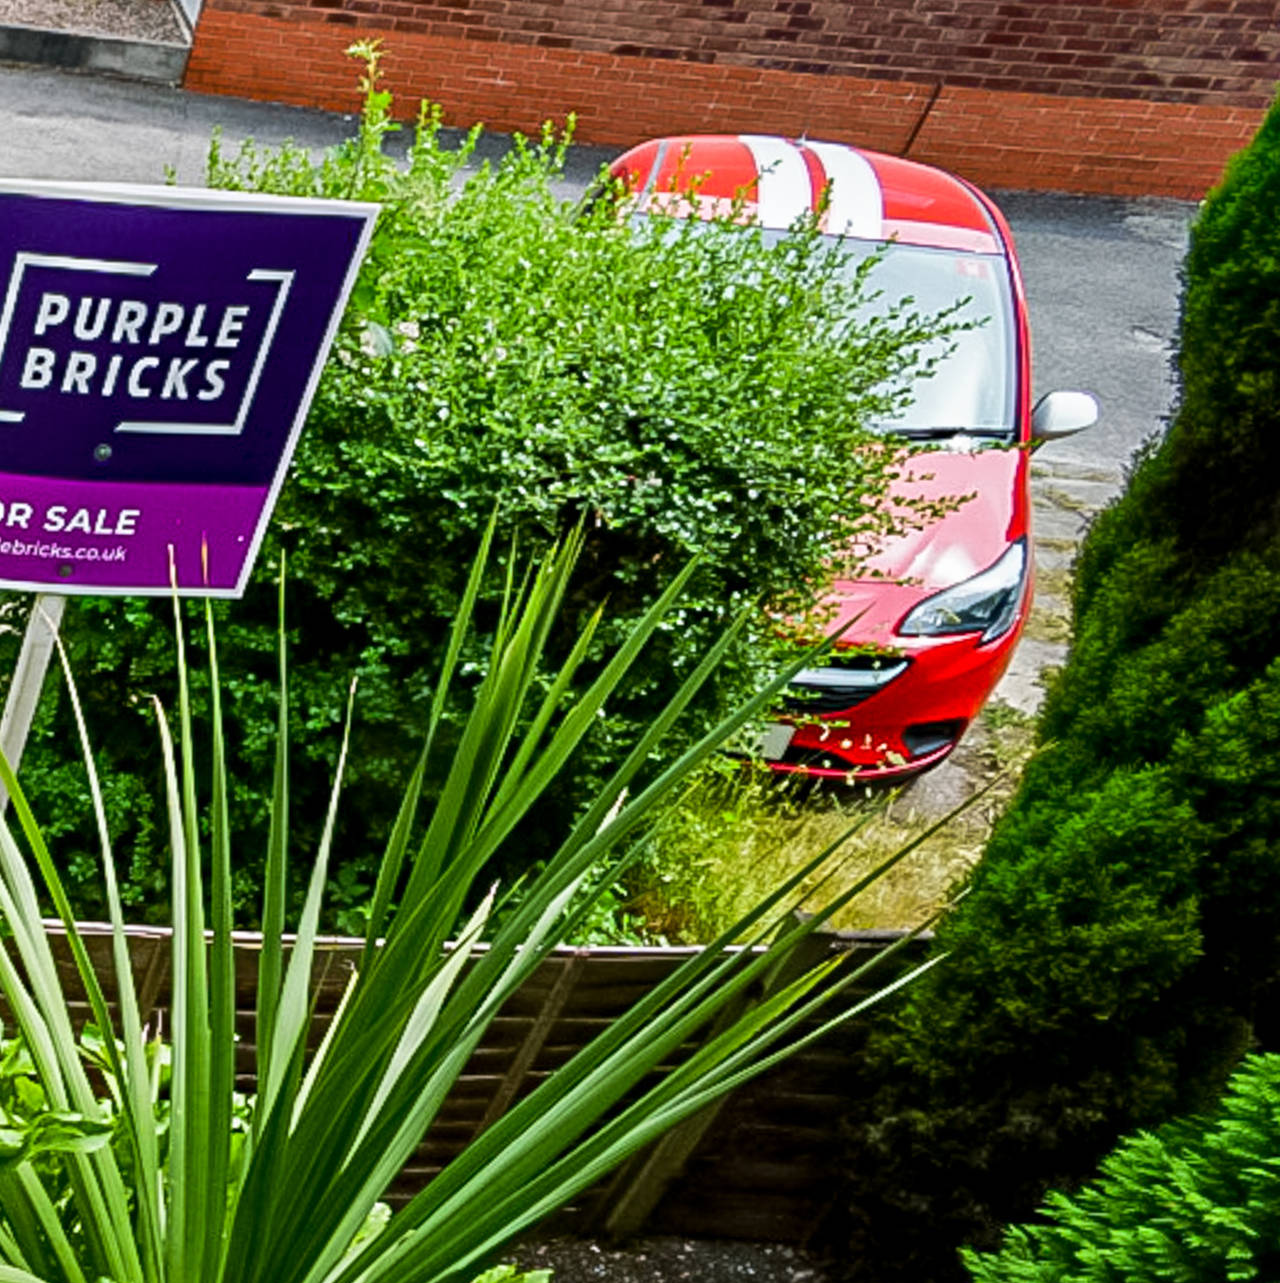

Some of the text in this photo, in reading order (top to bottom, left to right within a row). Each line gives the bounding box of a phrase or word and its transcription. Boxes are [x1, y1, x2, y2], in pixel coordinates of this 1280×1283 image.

[34, 293, 250, 347] PURPLE
[20, 347, 231, 400] BRICKS
[42, 505, 140, 536] SALE
